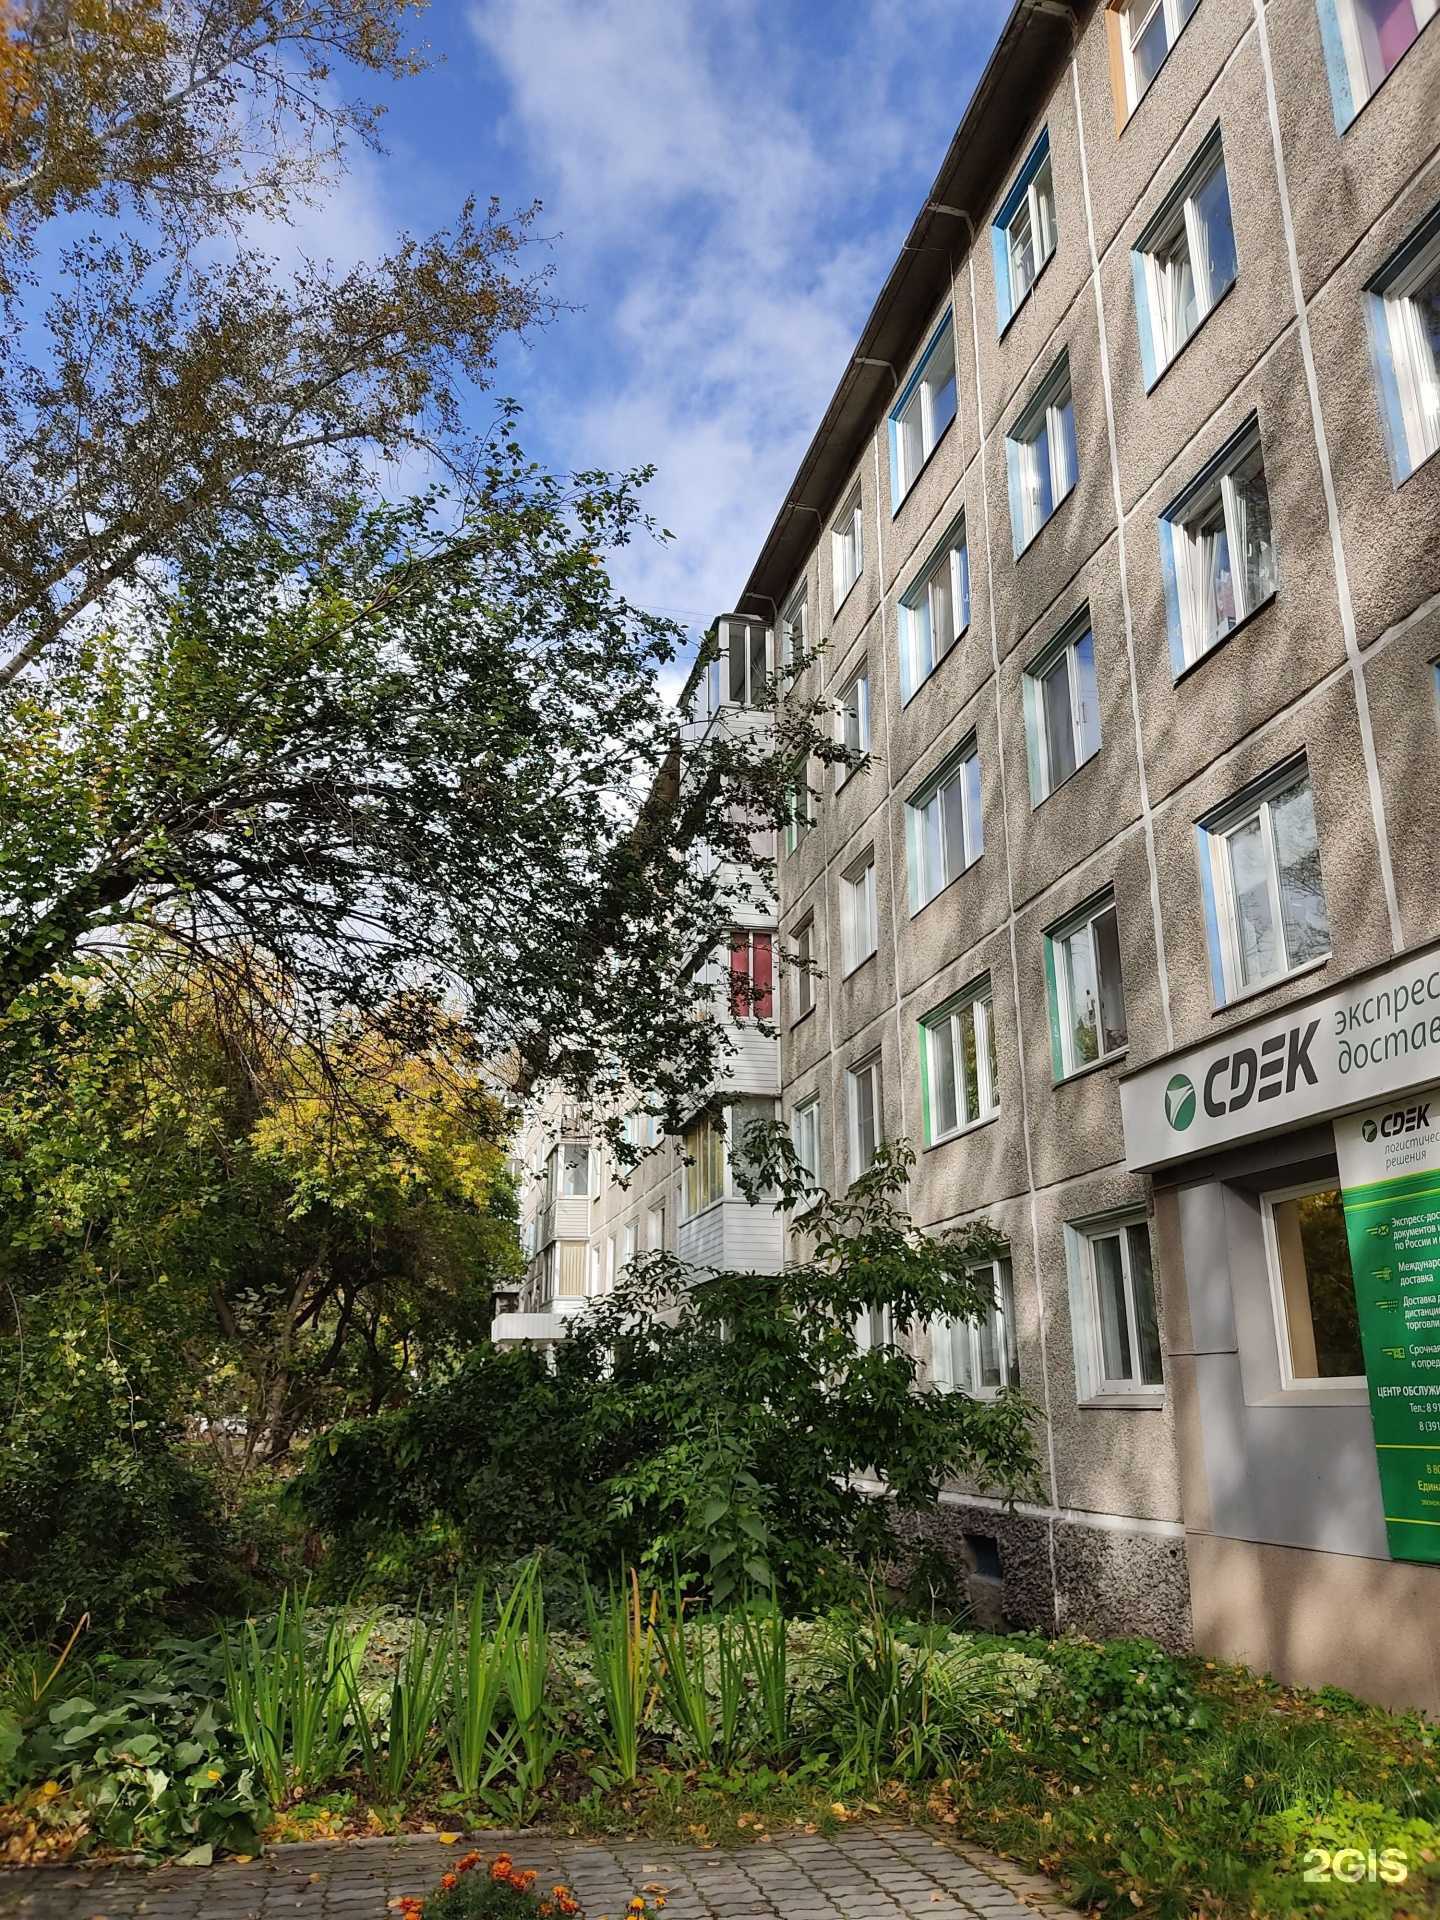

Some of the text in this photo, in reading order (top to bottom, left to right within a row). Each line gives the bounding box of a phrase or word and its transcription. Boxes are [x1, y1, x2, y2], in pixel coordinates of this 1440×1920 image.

[1335, 972, 1440, 1036] экспрес
[1338, 1016, 1440, 1074] достав
[1203, 1018, 1321, 1118] CDEK
[1381, 1103, 1431, 1138] CDEK
[1384, 1132, 1440, 1155] логистичес
[1385, 1150, 1427, 1172] решения
[1393, 1224, 1437, 1242] документов
[1395, 1242, 1404, 1251] по
[1405, 1237, 1432, 1249] России
[1400, 1274, 1434, 1287] доставка
[1403, 1294, 1437, 1308] Доставка
[1411, 1360, 1417, 1369] к
[1377, 1386, 1402, 1399] ЦЕНТР
[1426, 1402, 1432, 1413] 8
[1419, 1421, 1425, 1431] 8
